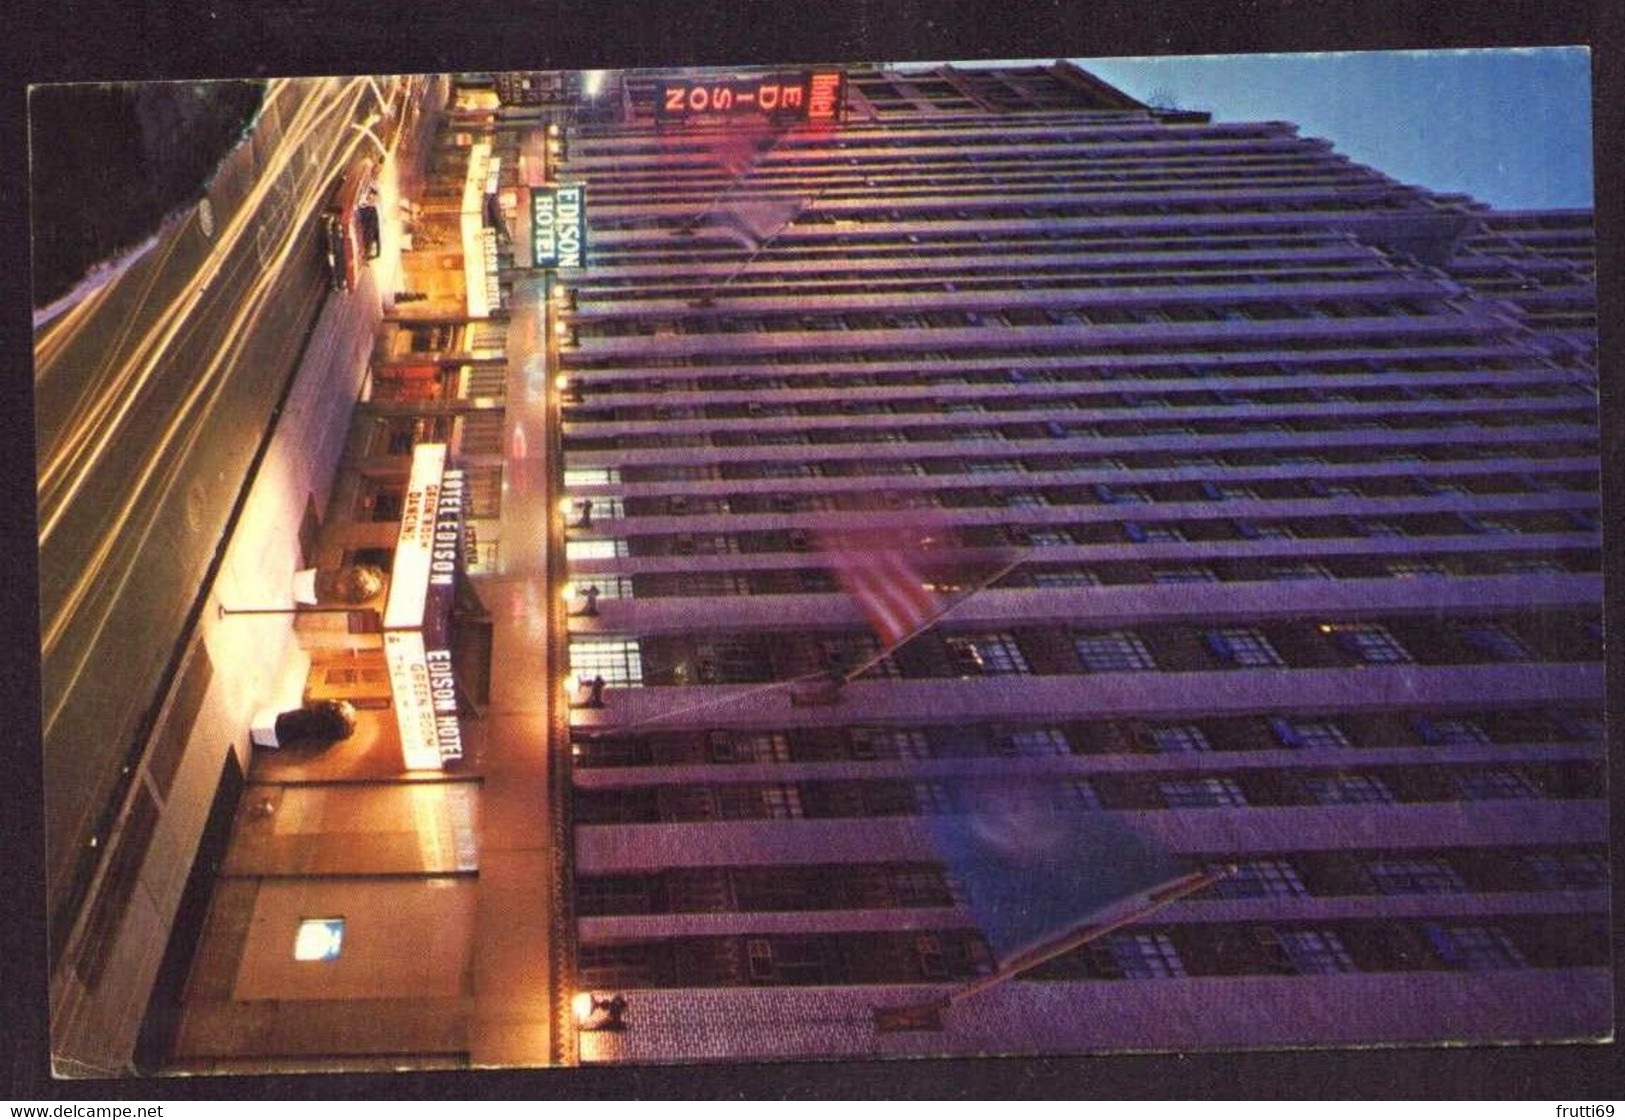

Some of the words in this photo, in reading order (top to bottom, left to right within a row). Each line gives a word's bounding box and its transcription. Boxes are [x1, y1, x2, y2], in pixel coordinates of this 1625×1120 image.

[665, 84, 802, 110] EDISON
[810, 74, 840, 117] Hotel
[534, 195, 557, 264] HOTEL
[556, 189, 582, 268] EDISON
[438, 469, 463, 515] HOTEL
[430, 521, 459, 585] EDISON
[411, 663, 430, 706] GREEN
[427, 649, 457, 711] EDISON
[436, 716, 463, 763] HOTEL
